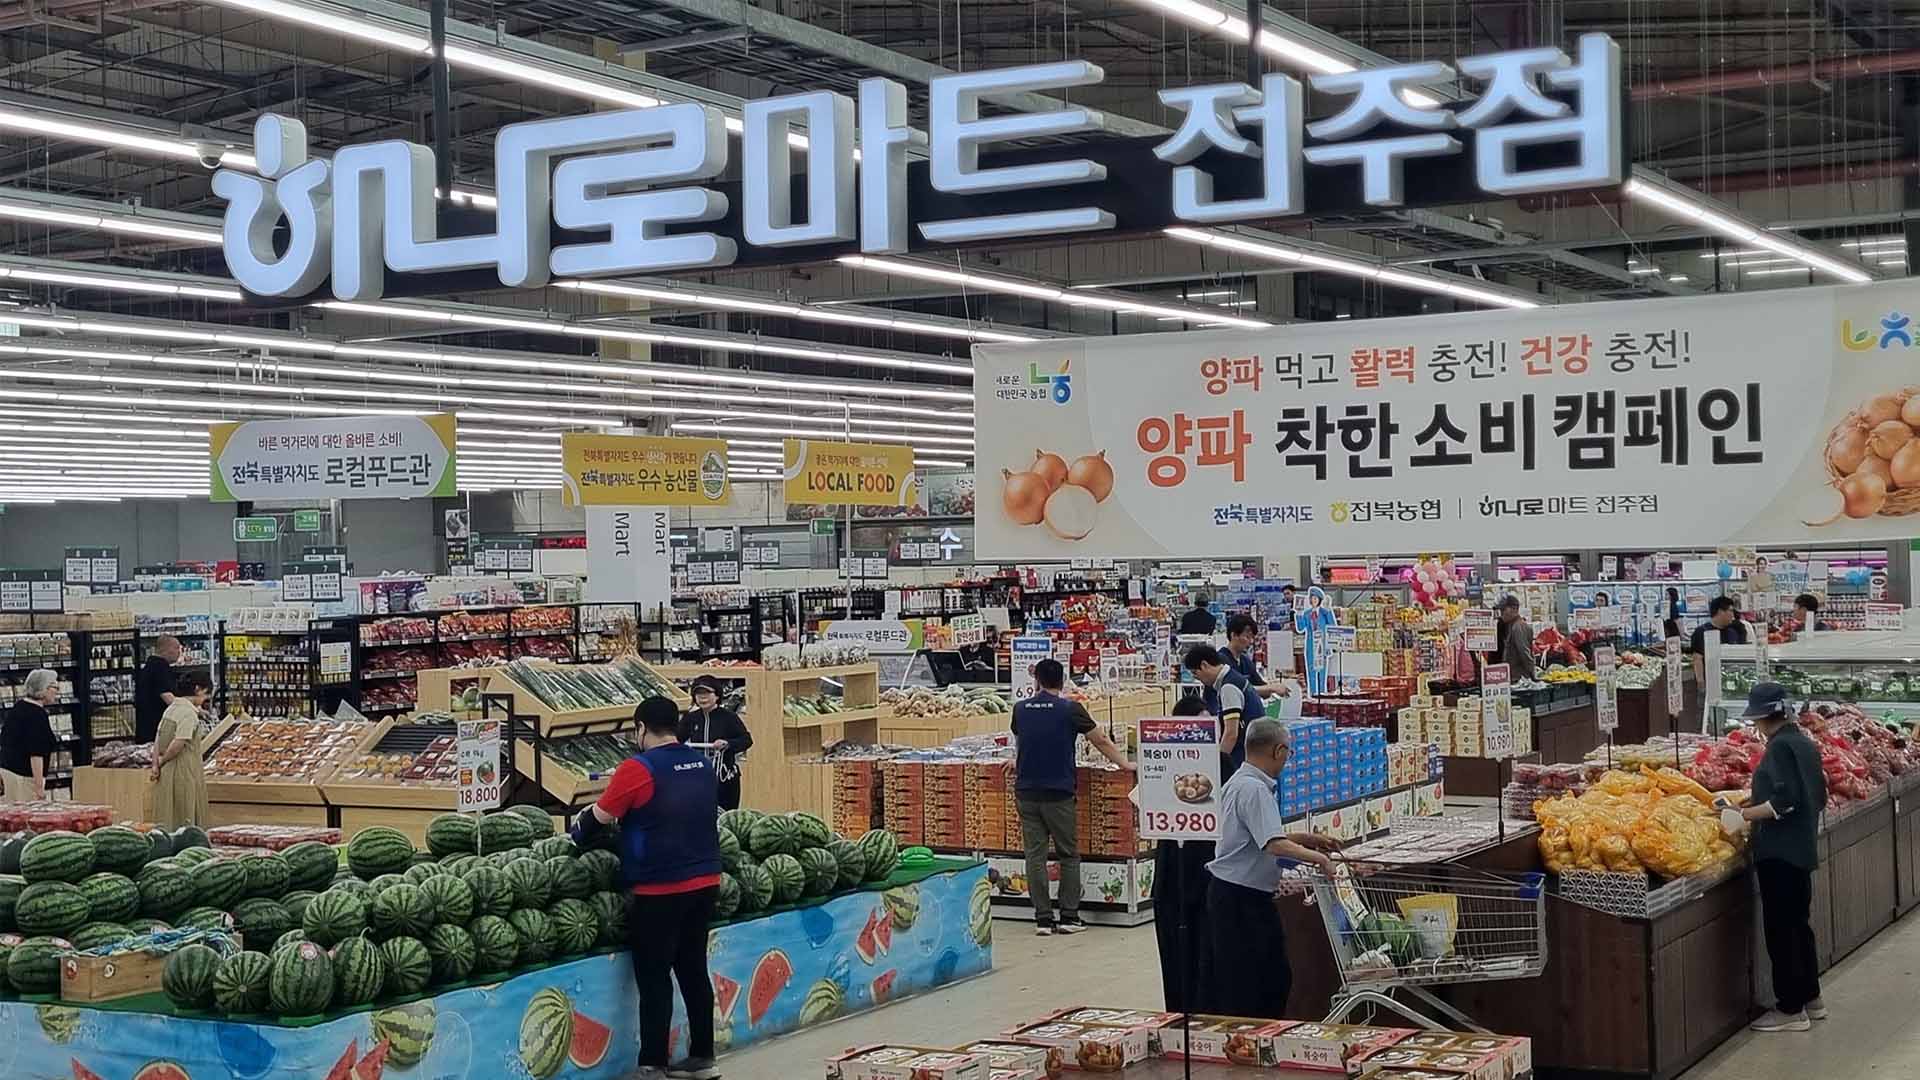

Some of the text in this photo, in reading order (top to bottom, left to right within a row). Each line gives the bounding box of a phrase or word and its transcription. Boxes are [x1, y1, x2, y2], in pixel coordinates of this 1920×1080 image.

[211, 32, 1621, 301] 하나로마트 전주점
[1200, 329, 1691, 395] 양파 먹고 활력 충전! 건강 충전!
[996, 388, 1047, 400] 대한민국 농협
[258, 431, 402, 451] 바른 먹거리에 대한 올바른 소비!
[1137, 383, 1764, 488] 양파 착한 소비 캠페인
[232, 454, 432, 488] 전북특별자치도 로컬푸드관
[637, 468, 661, 492] 우수
[664, 470, 698, 493] 농산물
[808, 471, 853, 492] LOCAL
[857, 473, 895, 493] FOOD
[1213, 503, 1314, 525] 전북특별자치도
[1350, 499, 1441, 522] 전북농협
[1479, 494, 1658, 517] 하나로마트 전주점
[615, 512, 630, 556] Mart
[655, 512, 666, 555] Mart
[865, 630, 907, 643] 로컬푸드관
[460, 786, 498, 805] 18,800
[1146, 812, 1217, 833] 13,980
